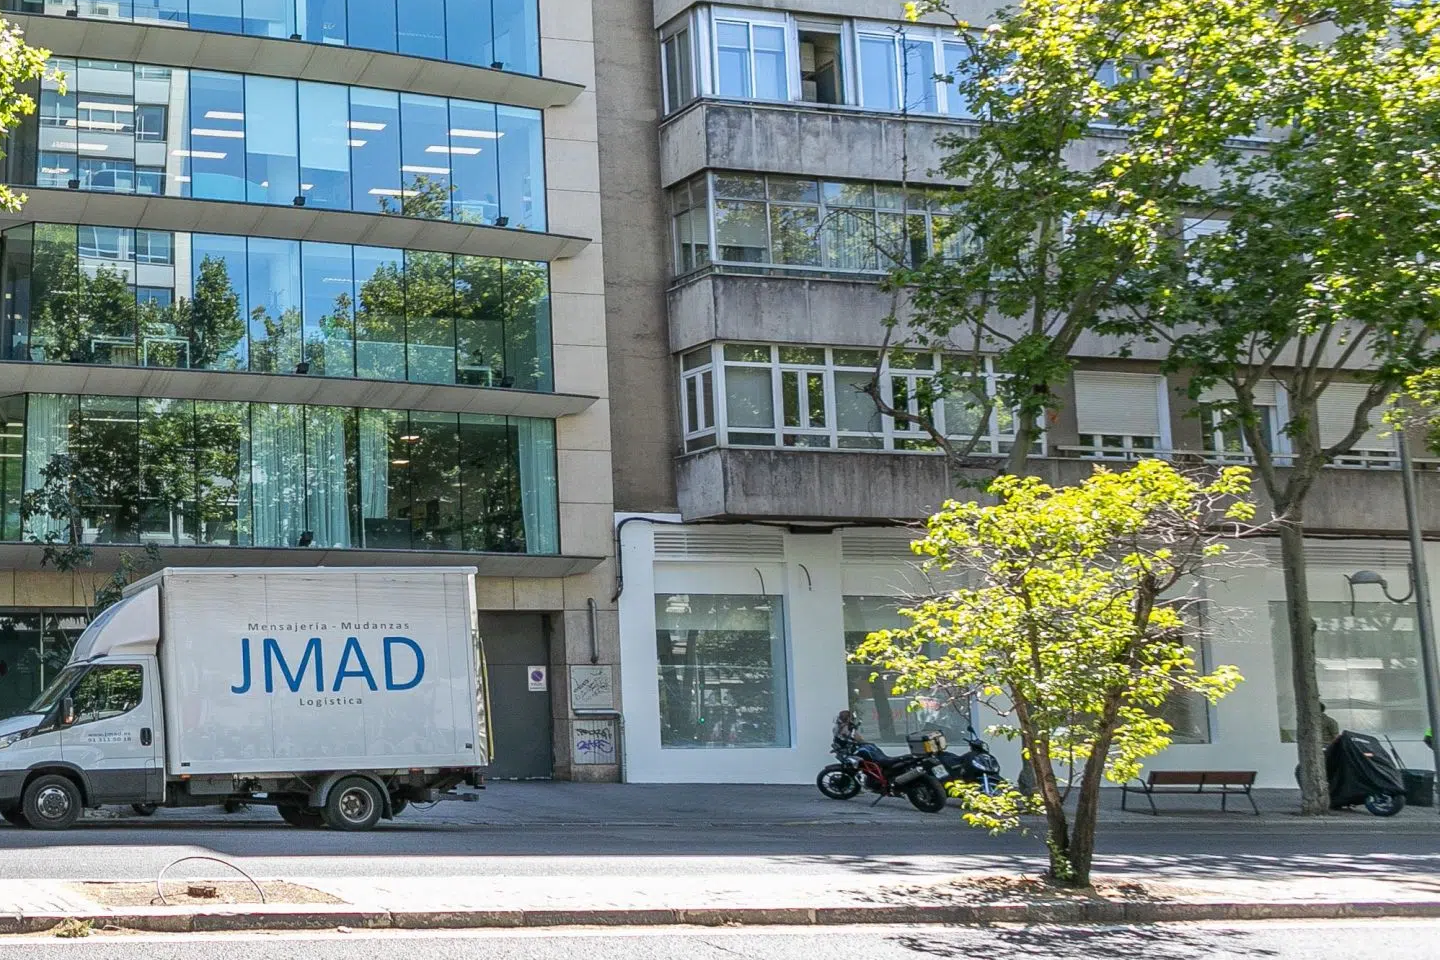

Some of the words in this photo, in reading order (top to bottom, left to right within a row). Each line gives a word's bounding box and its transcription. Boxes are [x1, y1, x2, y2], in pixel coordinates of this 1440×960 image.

[247, 622, 328, 632] Mensajería
[341, 621, 410, 630] Mudanzas
[231, 637, 425, 694] JMAD
